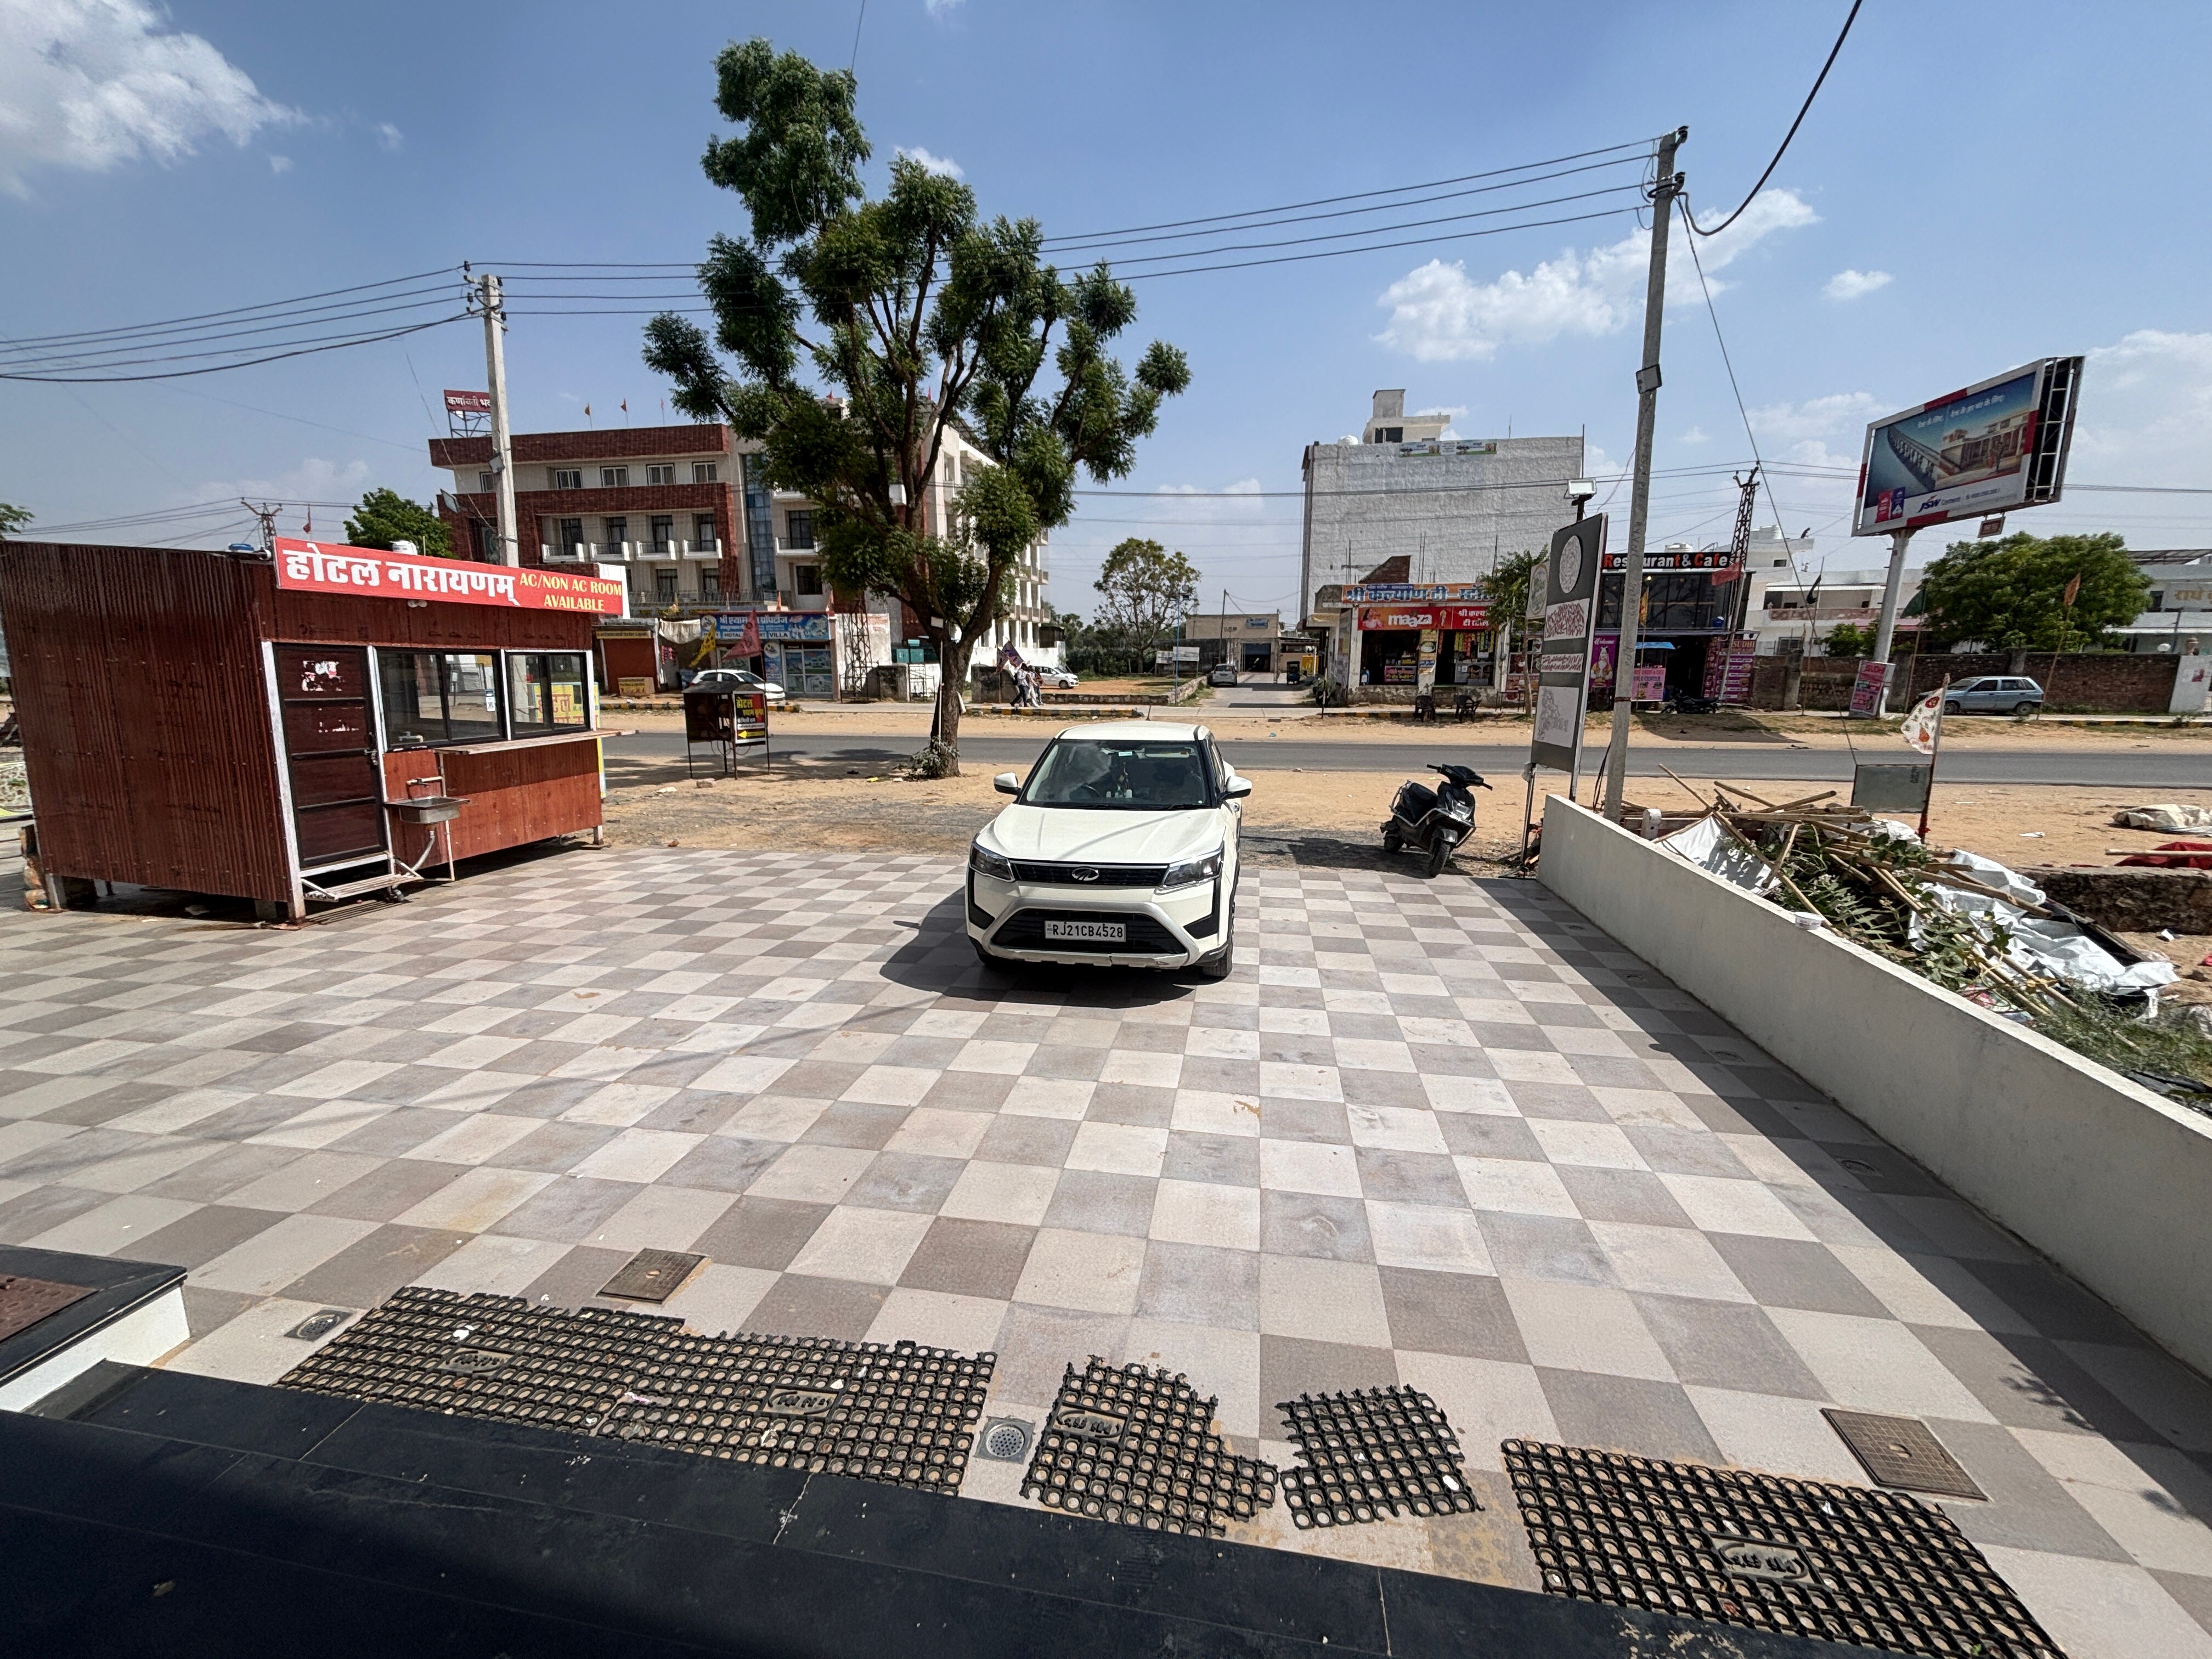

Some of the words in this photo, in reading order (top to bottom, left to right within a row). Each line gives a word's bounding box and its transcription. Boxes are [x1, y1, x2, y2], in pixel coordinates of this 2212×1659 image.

[1604, 553, 1680, 568] Resurant
[1681, 554, 1692, 567] &
[1694, 552, 1728, 567] Cafe
[283, 543, 382, 586] होटल
[385, 561, 521, 607] नारायणम्
[520, 573, 568, 590] AC/NON
[572, 579, 587, 592] AC
[590, 581, 622, 596] ROOM
[1346, 586, 1365, 602] श्री
[544, 594, 605, 612] AVAILABLE
[1388, 613, 1432, 628] maaza
[736, 696, 753, 709] होटल
[1052, 924, 1123, 938] RJ21CB4528
